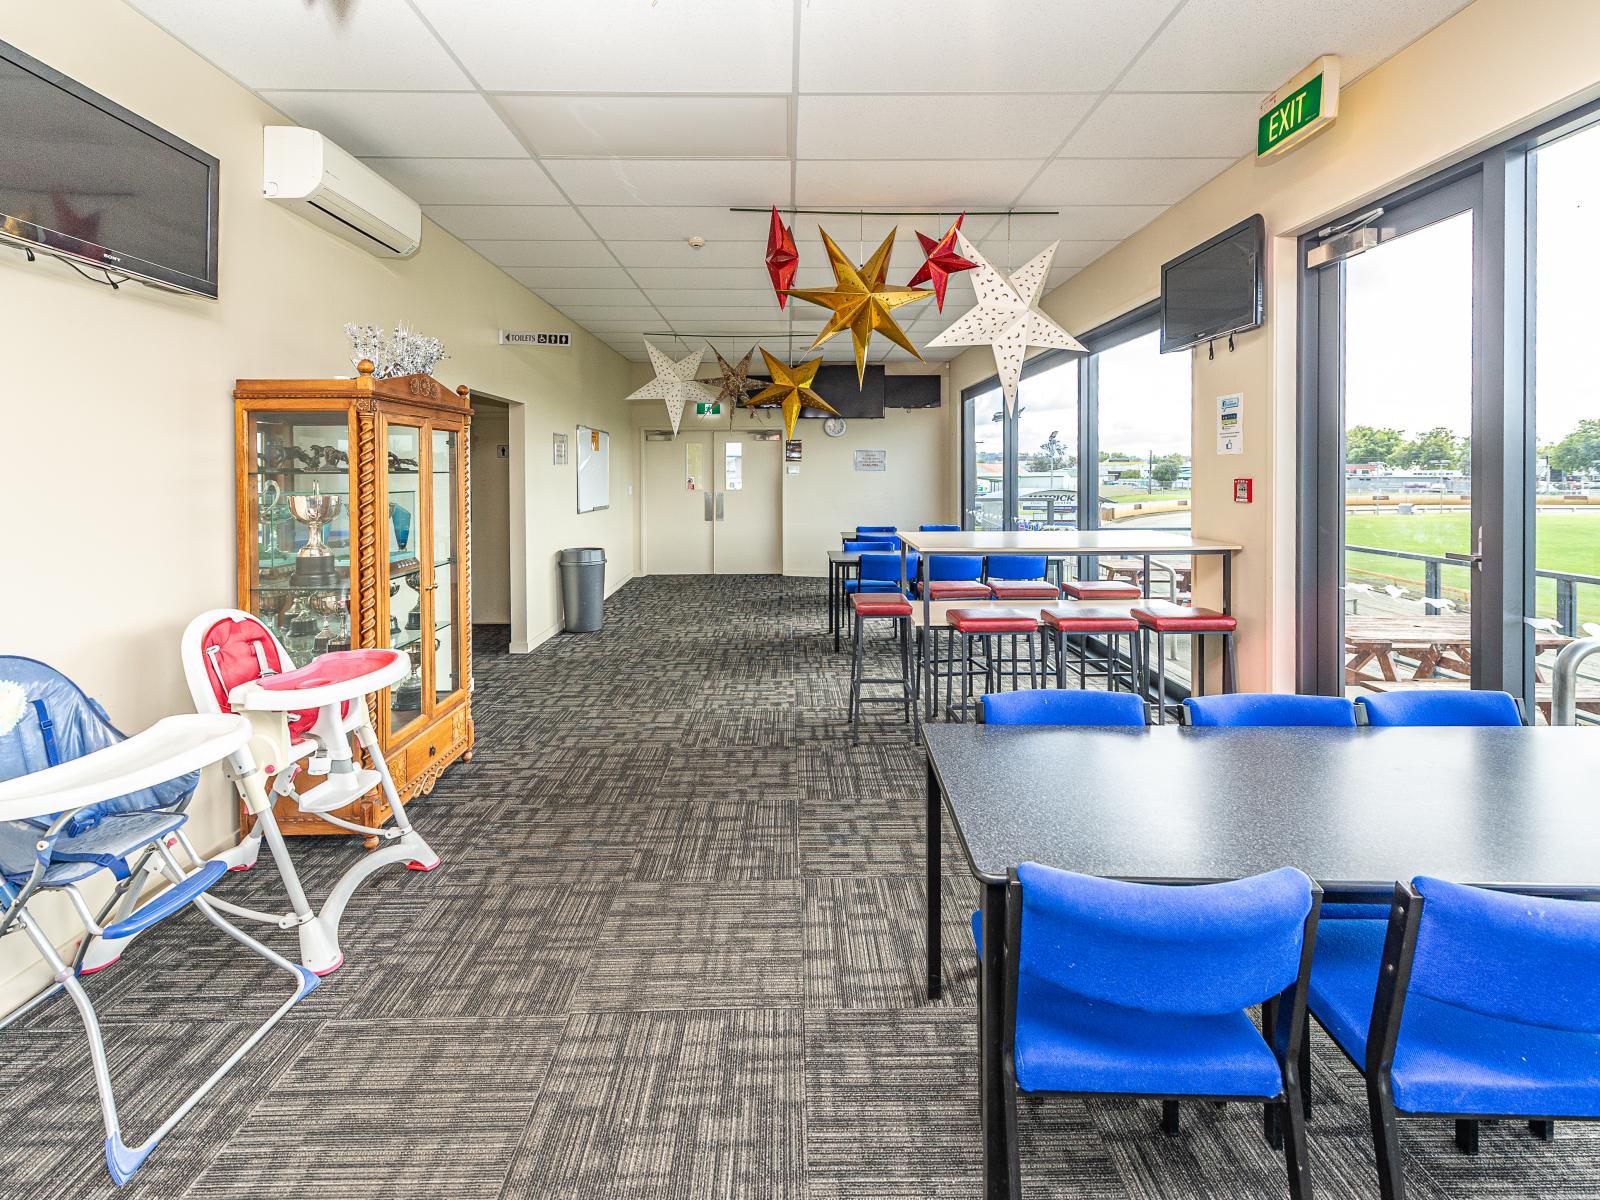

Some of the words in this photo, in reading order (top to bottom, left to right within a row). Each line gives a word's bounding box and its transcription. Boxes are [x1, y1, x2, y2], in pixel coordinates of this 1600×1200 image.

[1269, 91, 1307, 143] EXIT
[103, 253, 121, 262] SONY
[511, 334, 536, 342] TOILETS
